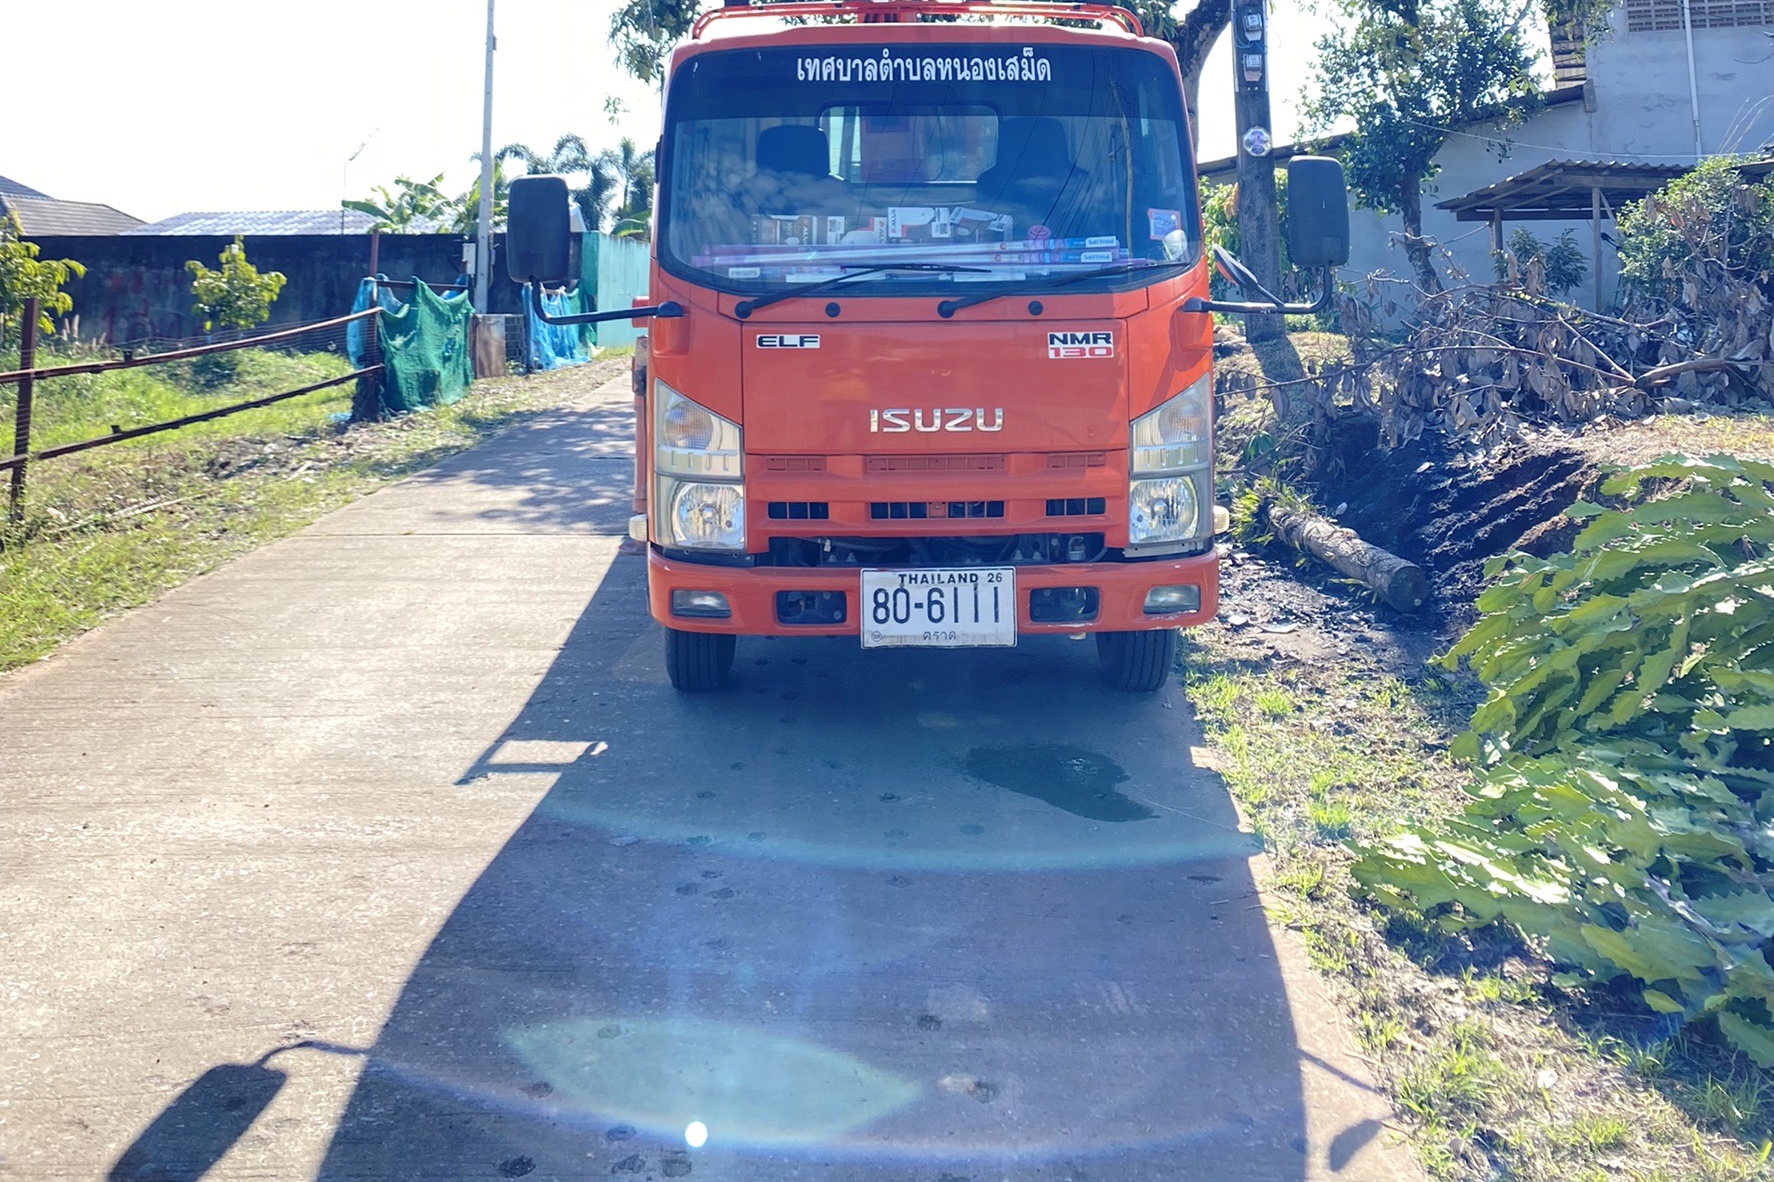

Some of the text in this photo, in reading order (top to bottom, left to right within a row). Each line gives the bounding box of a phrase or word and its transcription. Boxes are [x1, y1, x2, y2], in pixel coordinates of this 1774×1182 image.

[797, 47, 1052, 81] เทศบาลตำบลหนองเสม็ด
[758, 336, 819, 347] ELF
[1049, 333, 1112, 345] NMR
[1050, 346, 1113, 357] 130
[870, 408, 1003, 432] ISUZU
[898, 572, 1003, 584] THAILAND 26
[872, 586, 1000, 624] 80-6111
[922, 630, 957, 641] ตราด
